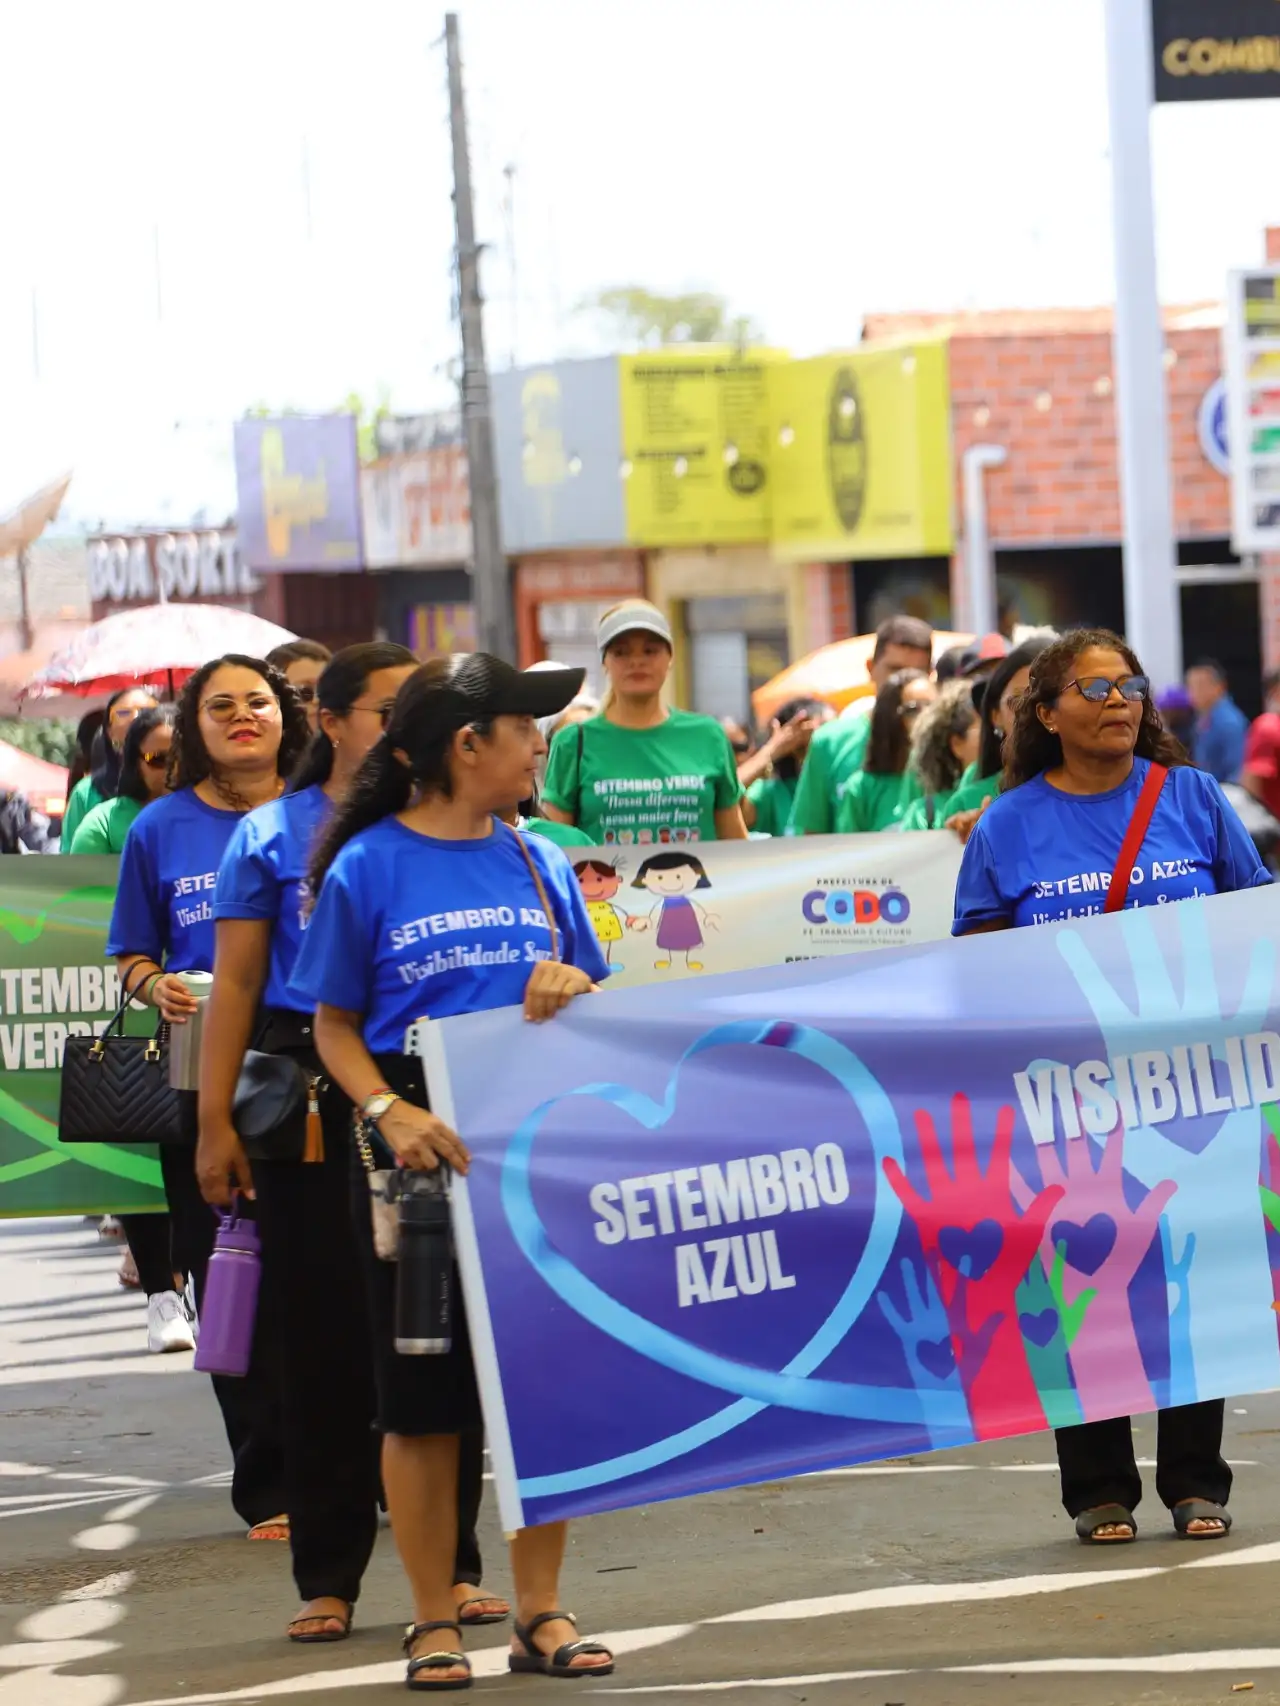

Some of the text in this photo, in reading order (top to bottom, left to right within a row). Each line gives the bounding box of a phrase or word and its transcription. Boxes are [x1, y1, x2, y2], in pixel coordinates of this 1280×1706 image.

[594, 778, 663, 796] SETEMBRO
[1032, 866, 1144, 899] SETEMBO
[389, 906, 515, 950] SETEMBRO
[397, 941, 520, 984] Visibilidade
[0, 965, 148, 1015] TEMBR
[0, 1019, 112, 1070] VER
[589, 1142, 850, 1245] SETEMBRO
[675, 1229, 797, 1308] AZUL
